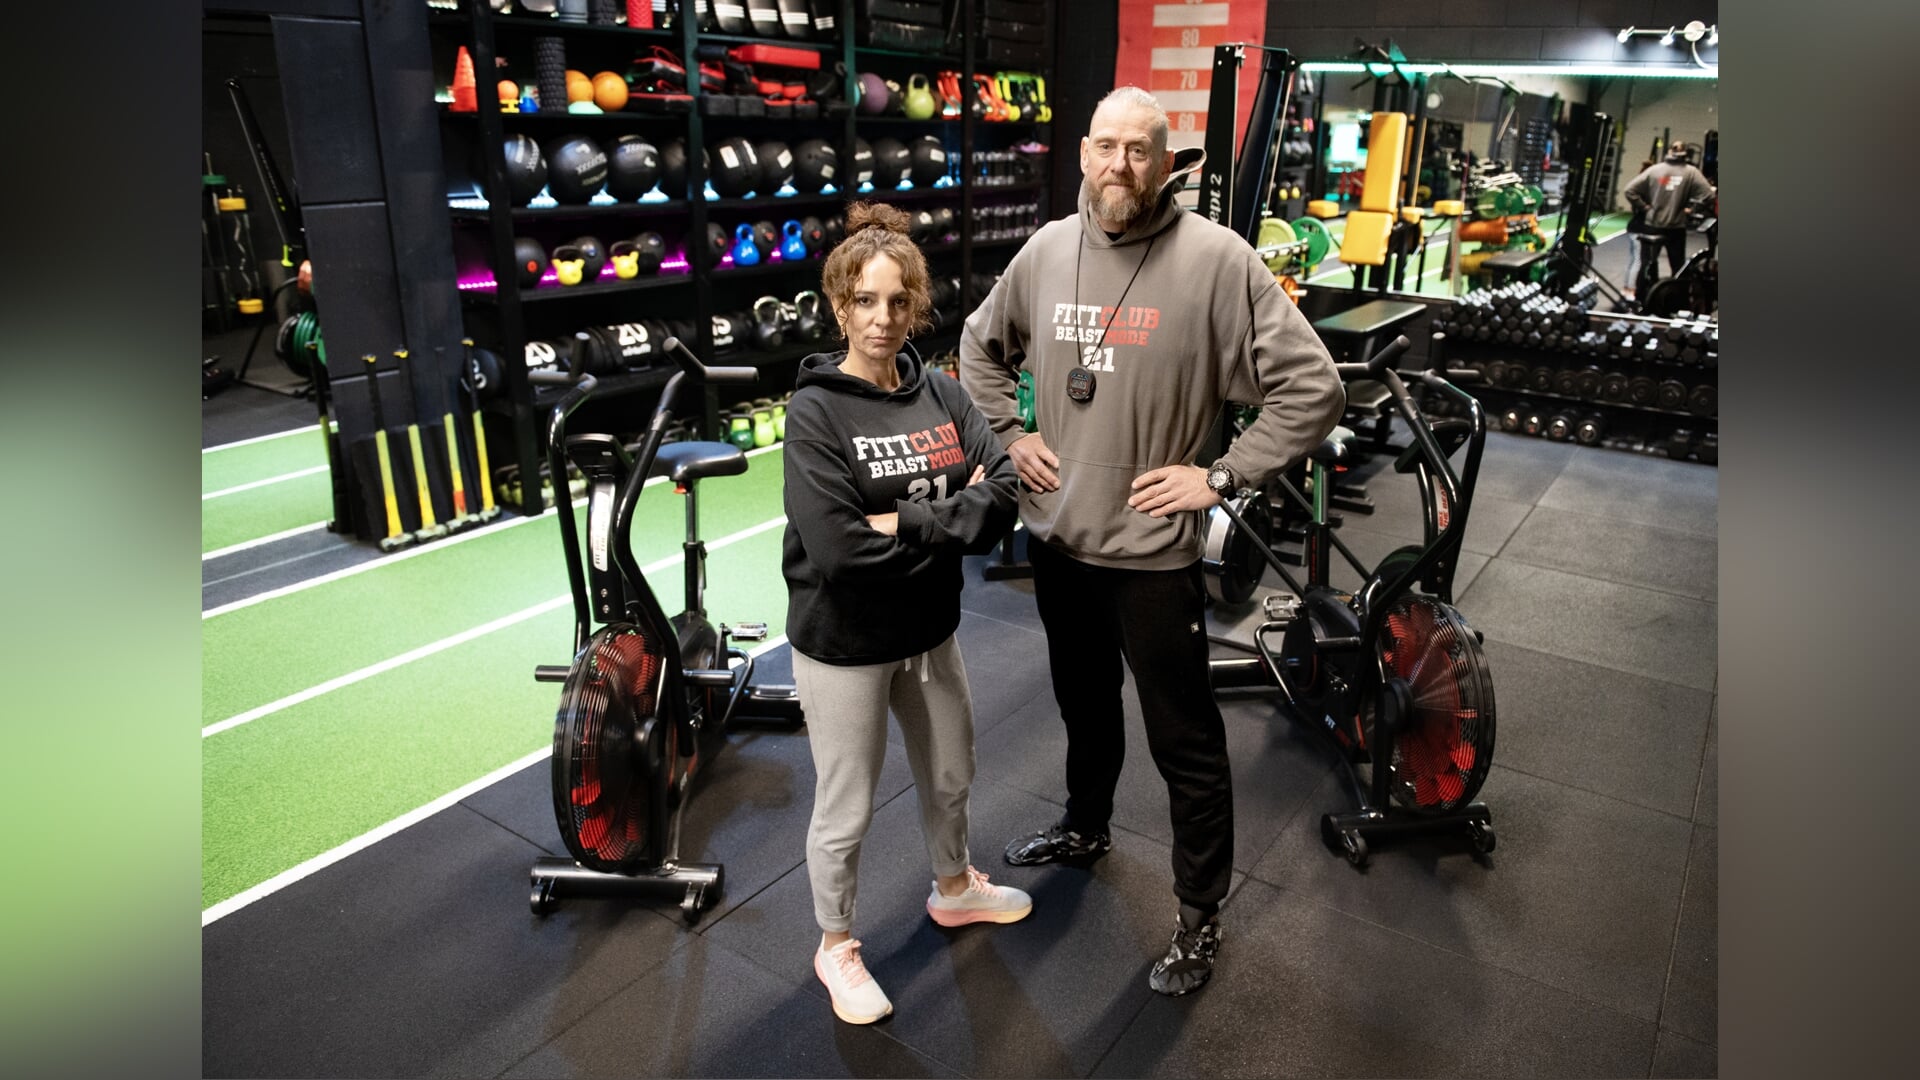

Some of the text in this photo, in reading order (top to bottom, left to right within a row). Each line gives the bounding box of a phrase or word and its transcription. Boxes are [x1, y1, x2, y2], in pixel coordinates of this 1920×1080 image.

[1181, 29, 1199, 47] 80
[1180, 70, 1197, 88] 70
[1178, 114, 1196, 131] 60
[1210, 173, 1222, 187] 2
[1083, 345, 1115, 372] 21
[852, 421, 960, 461] FITTCLU
[907, 474, 948, 503] 21
